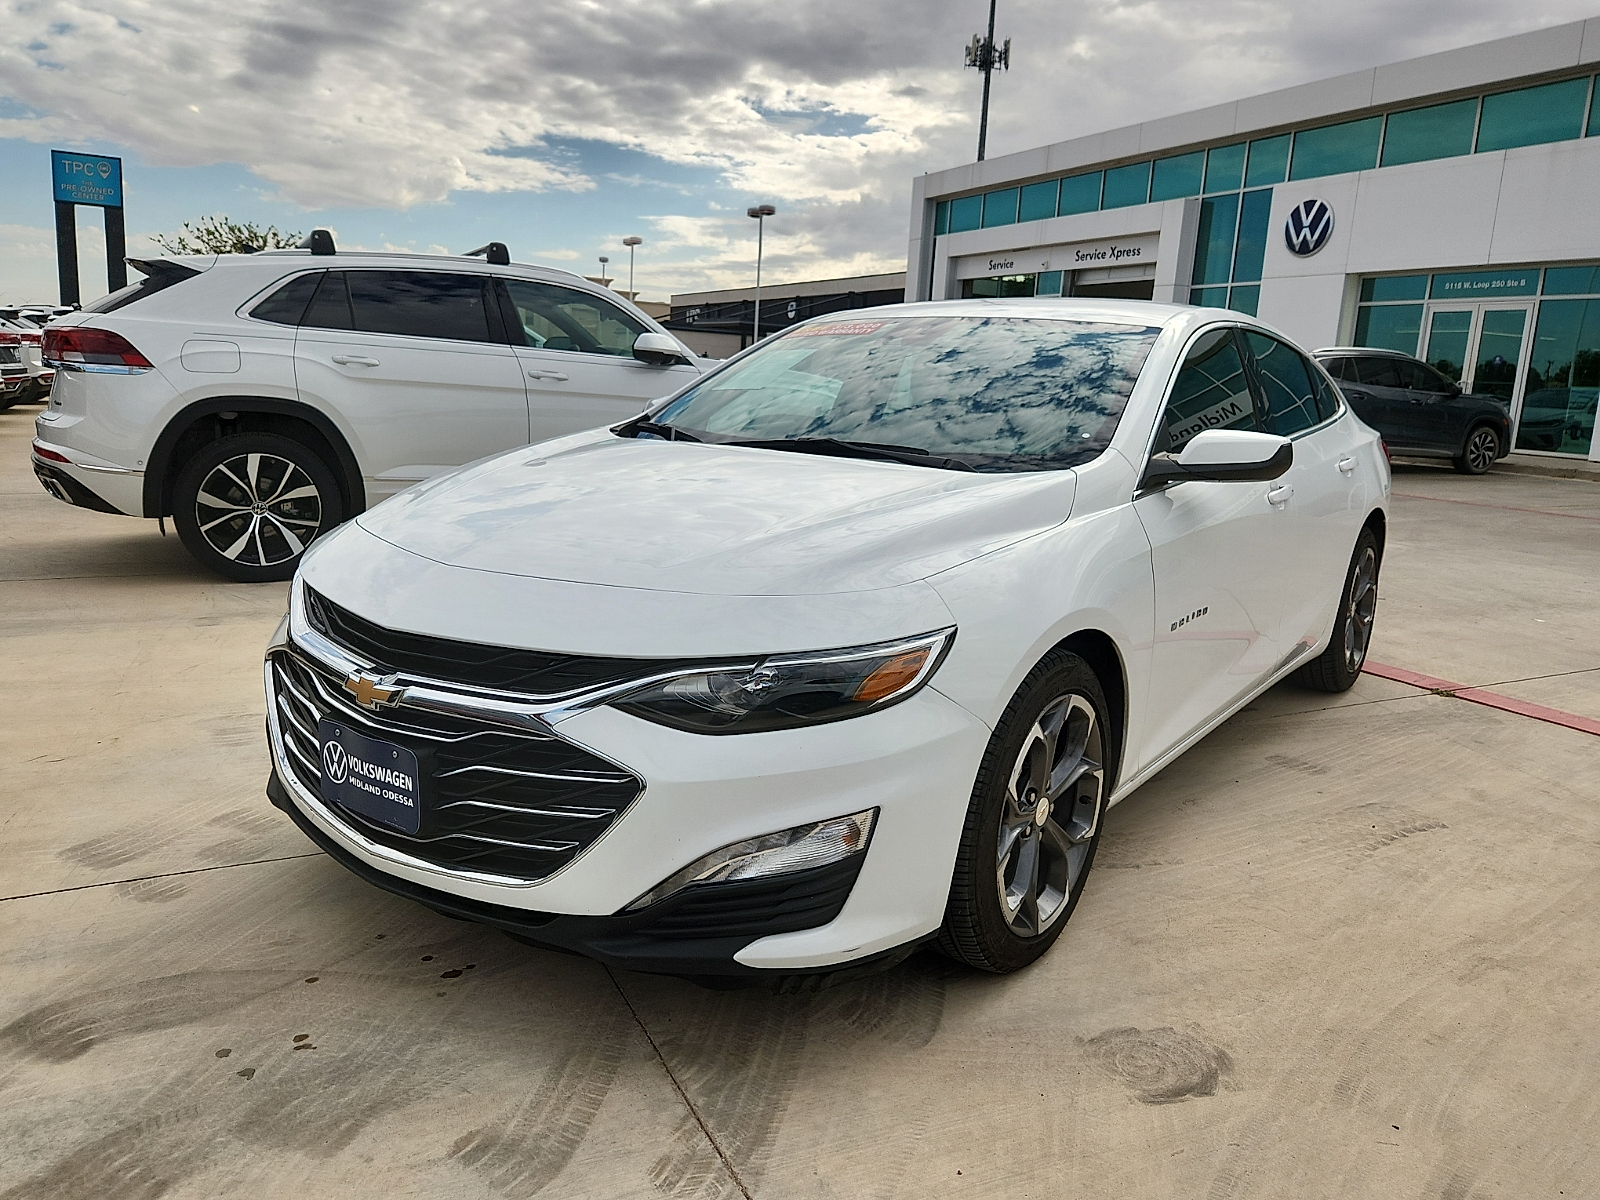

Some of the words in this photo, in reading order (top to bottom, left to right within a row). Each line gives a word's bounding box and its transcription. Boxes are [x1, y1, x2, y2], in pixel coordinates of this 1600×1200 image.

[61, 159, 95, 176] TPC
[61, 183, 115, 196] PRE-OWNED
[71, 191, 105, 201] CENTER
[1074, 248, 1107, 262] Service
[1108, 246, 1141, 261] Xpress
[988, 259, 1014, 271] Service
[1473, 281, 1490, 289] Loop
[347, 753, 413, 792] VOLKSWAGEN
[348, 775, 381, 796] MIDLAND
[382, 789, 415, 808] ODESSA
